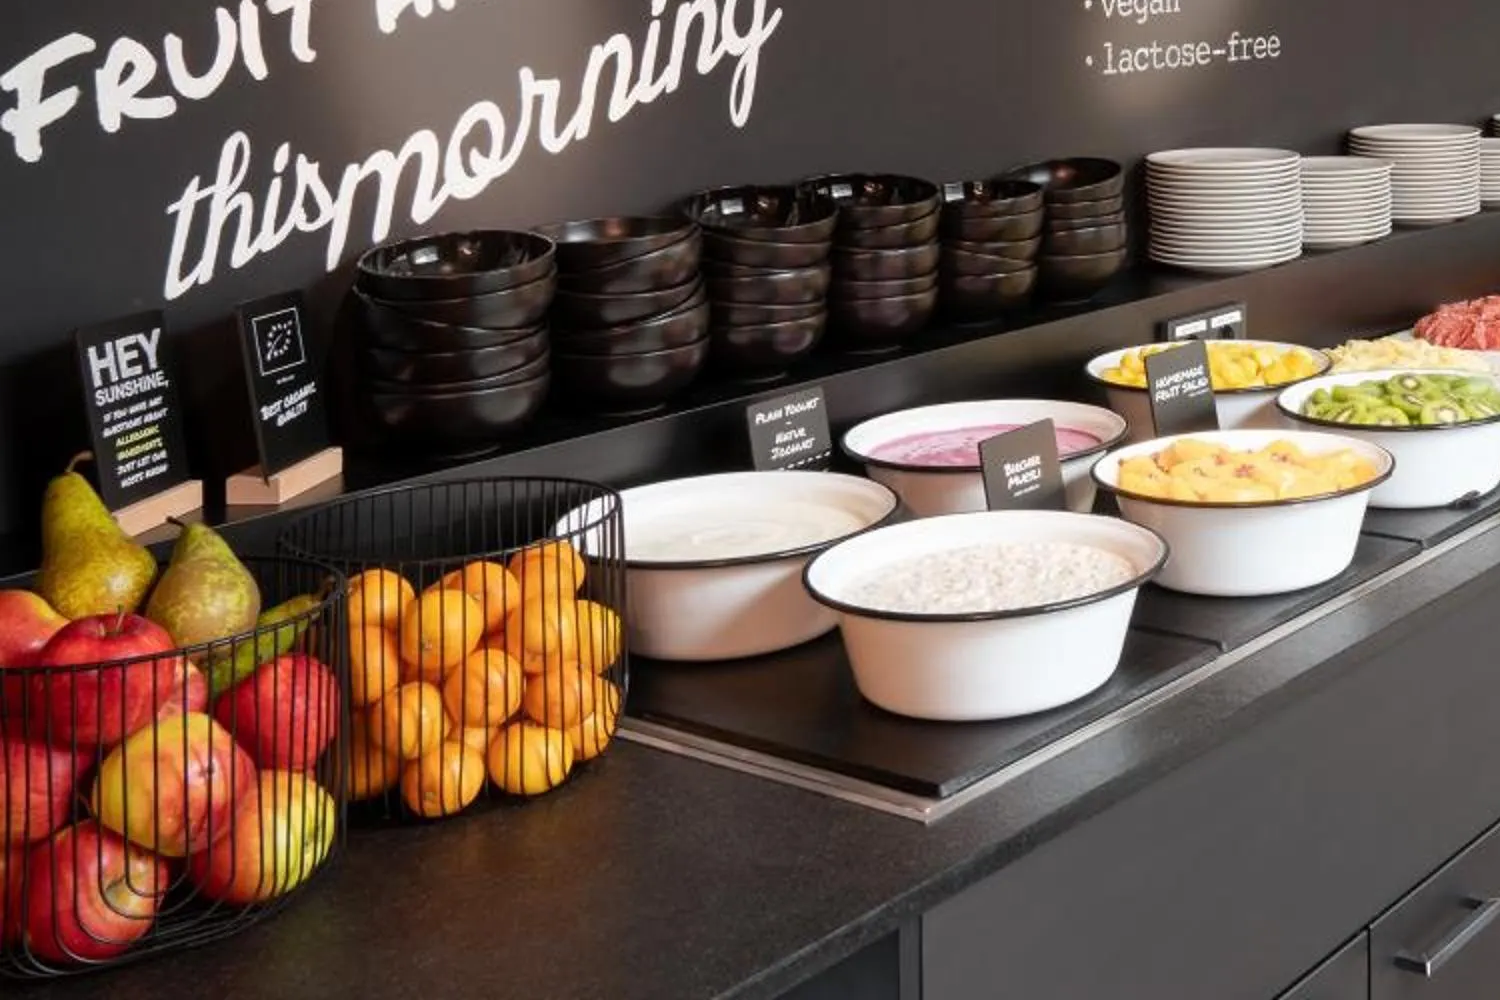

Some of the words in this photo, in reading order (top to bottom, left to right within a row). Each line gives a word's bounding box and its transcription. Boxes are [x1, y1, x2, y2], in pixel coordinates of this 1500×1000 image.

[1103, 32, 1281, 75] lactose-free
[87, 328, 161, 388] HEY
[95, 370, 169, 407] SUNSHINE,
